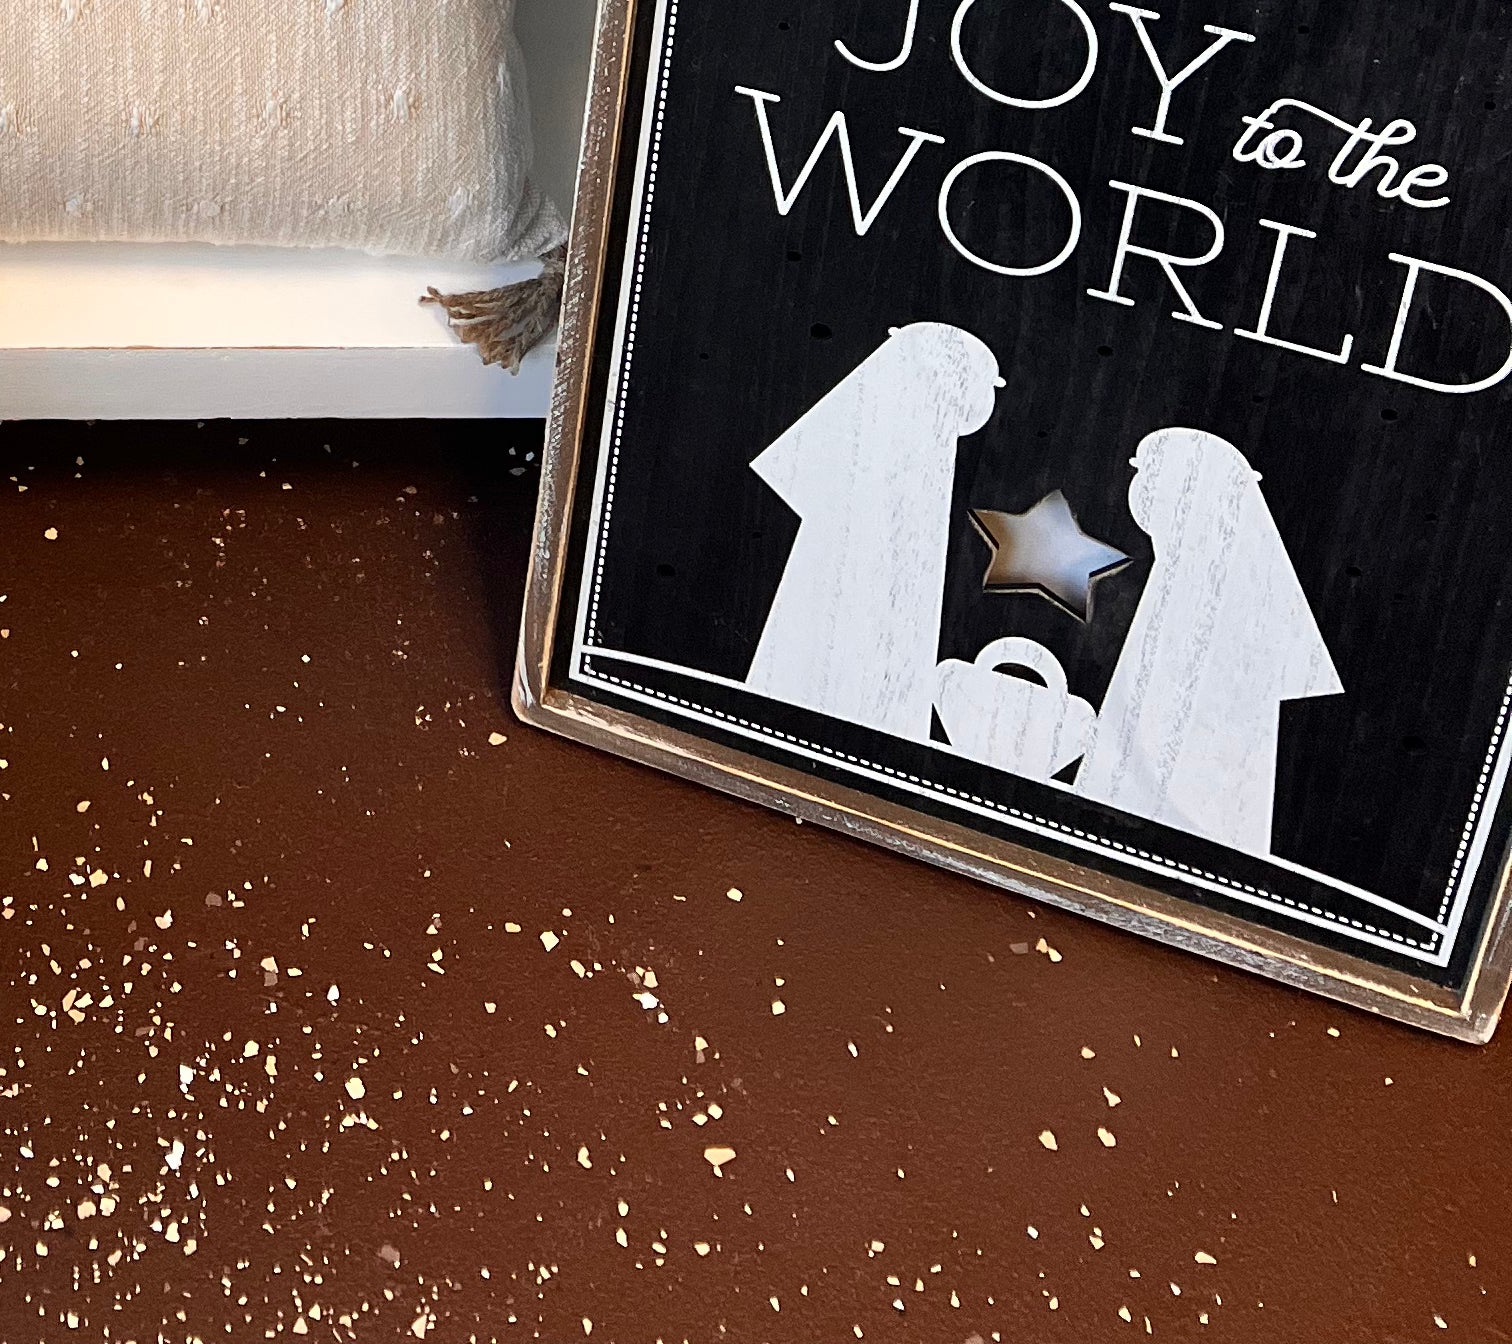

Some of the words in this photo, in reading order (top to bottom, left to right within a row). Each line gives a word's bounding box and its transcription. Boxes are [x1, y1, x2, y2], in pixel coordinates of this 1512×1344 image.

[734, 85, 1512, 395] WORLD
[1232, 98, 1307, 170] to
[1328, 118, 1451, 208] the
